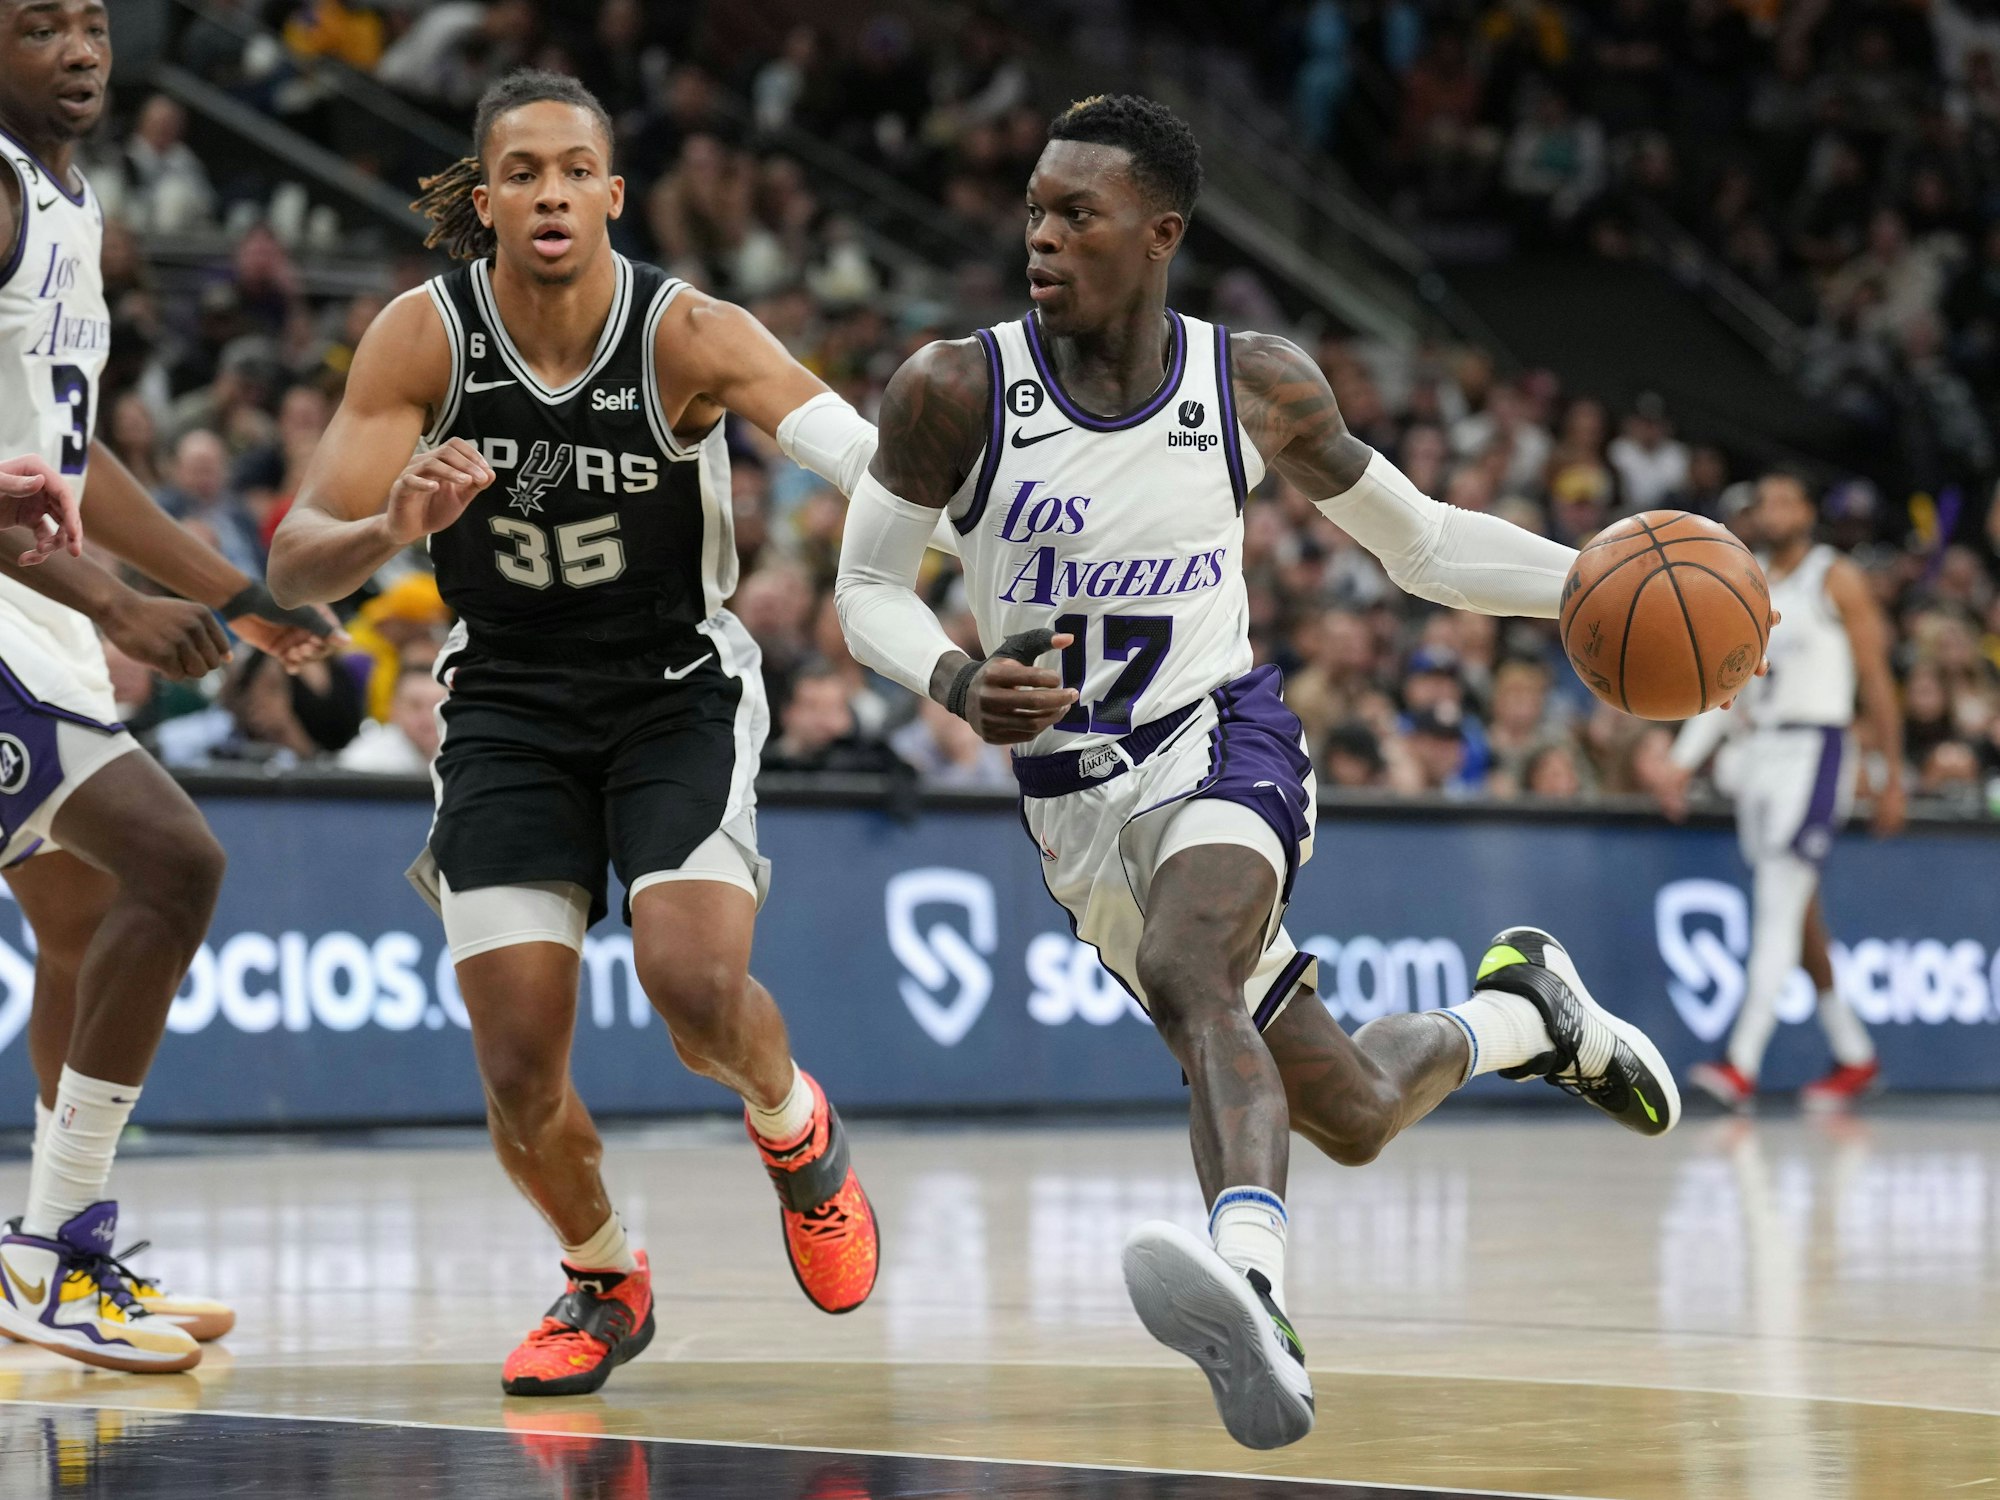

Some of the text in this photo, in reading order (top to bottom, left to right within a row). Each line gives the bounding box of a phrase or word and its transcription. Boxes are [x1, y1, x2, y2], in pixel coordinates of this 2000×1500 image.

[22, 301, 110, 356] ANGELE
[470, 332, 486, 359] 6
[1015, 384, 1035, 413] 6
[1168, 431, 1218, 451] bibigo
[465, 437, 658, 505] PURS
[488, 512, 627, 591] 35
[998, 546, 1226, 607] ANGELES
[1054, 614, 1173, 735] 17
[1081, 749, 1119, 776] LAKERS
